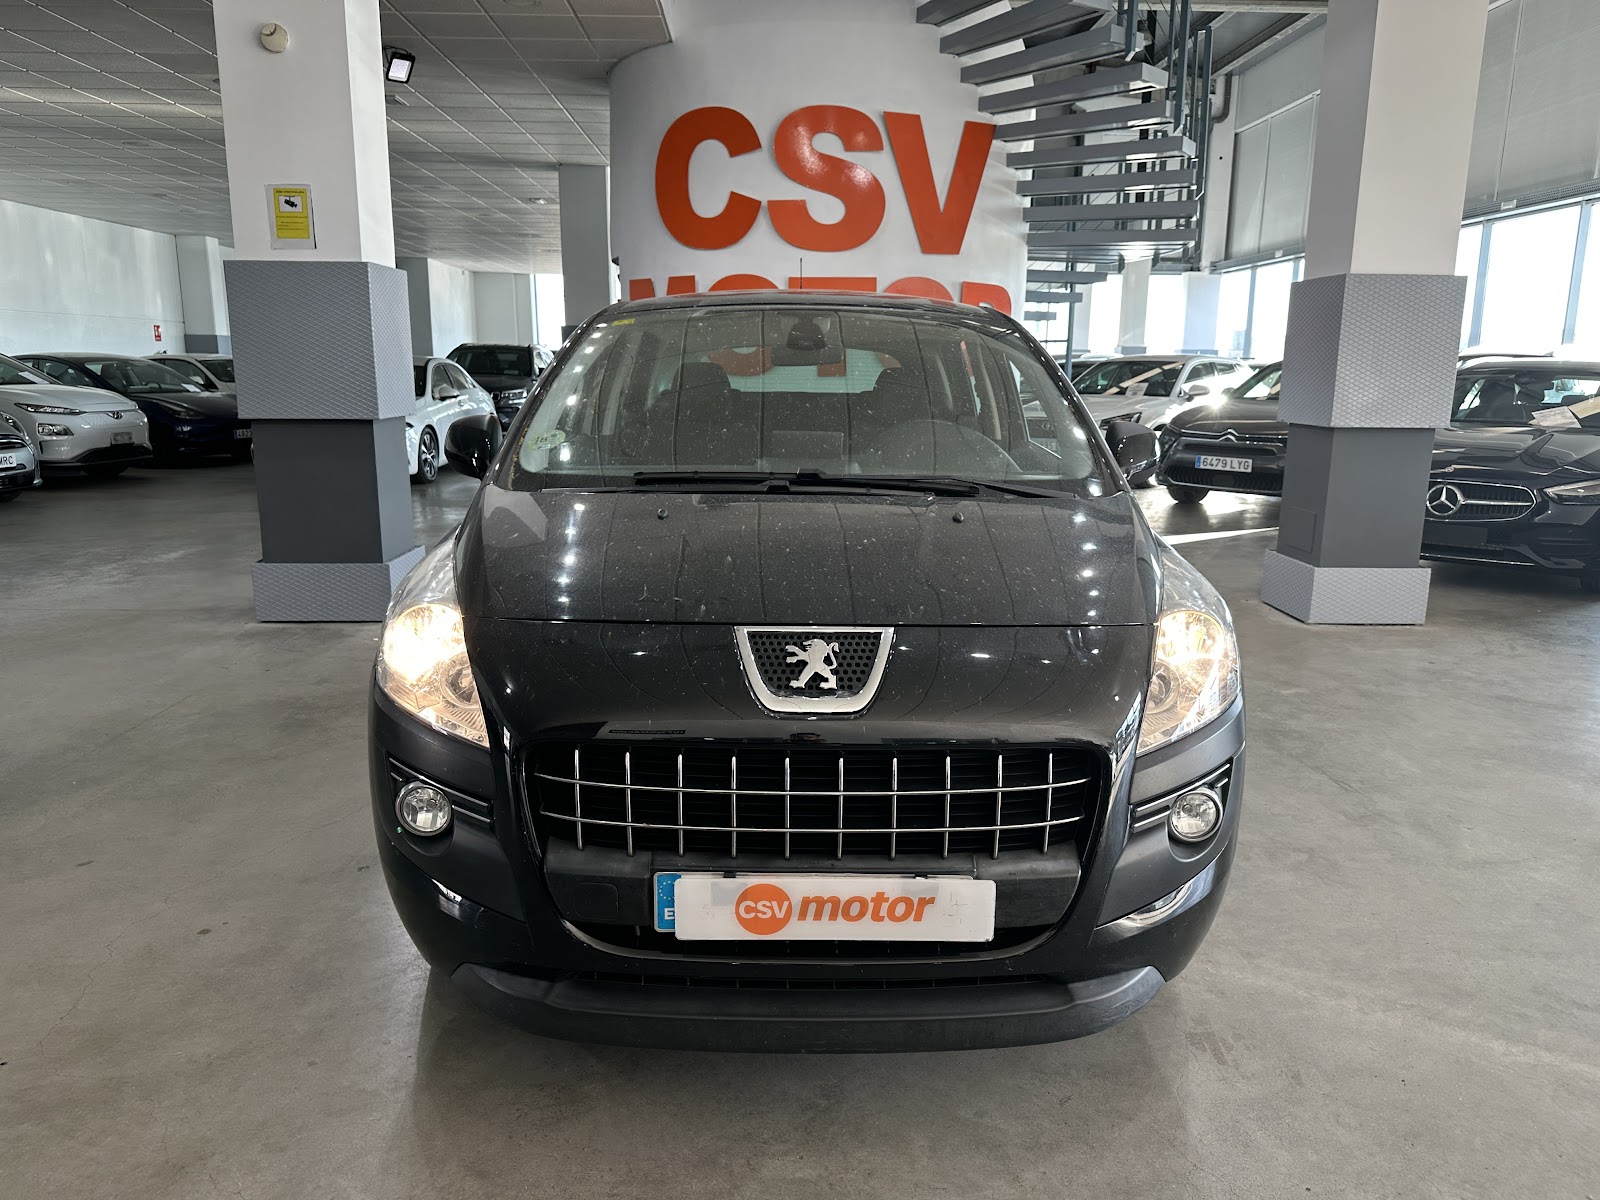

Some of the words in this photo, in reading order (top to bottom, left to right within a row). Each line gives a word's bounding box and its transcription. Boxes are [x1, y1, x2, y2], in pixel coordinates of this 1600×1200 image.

[655, 104, 998, 255] CSV
[1202, 457, 1228, 468] 6479
[1230, 459, 1250, 470] LYG
[738, 900, 790, 919] CSV
[797, 891, 936, 923] motor
